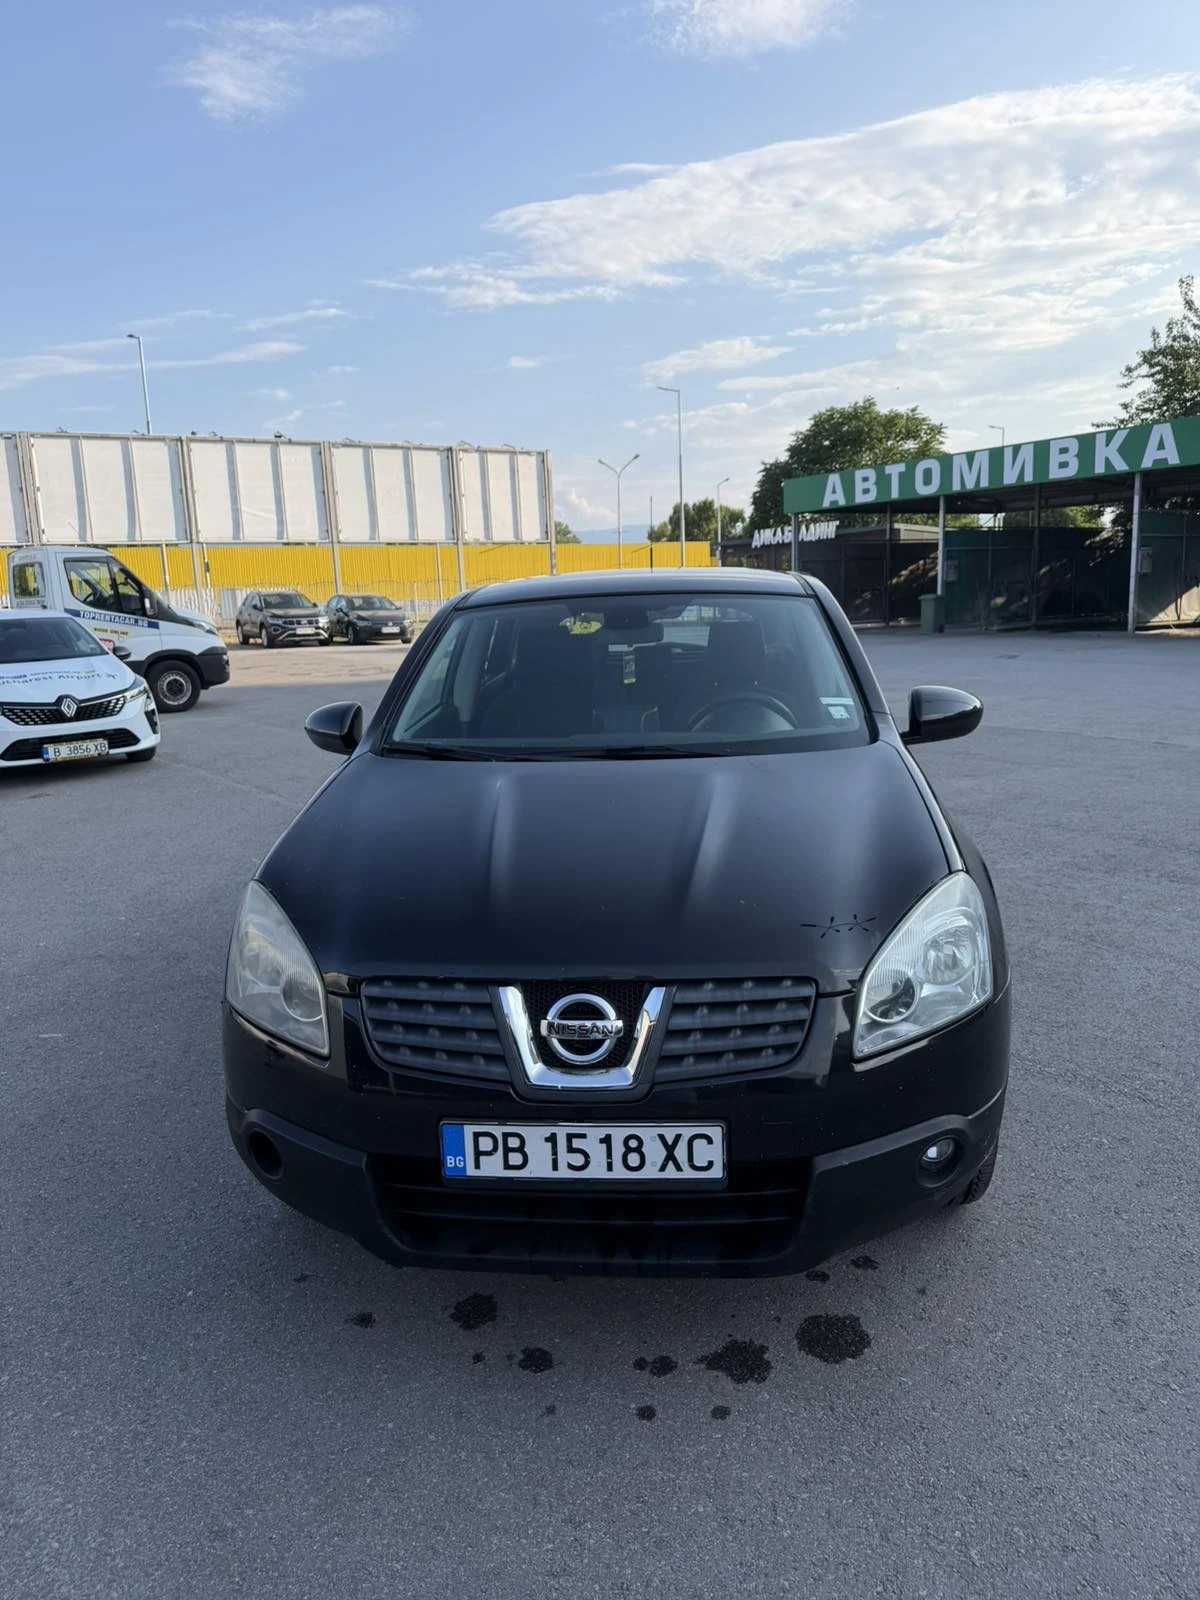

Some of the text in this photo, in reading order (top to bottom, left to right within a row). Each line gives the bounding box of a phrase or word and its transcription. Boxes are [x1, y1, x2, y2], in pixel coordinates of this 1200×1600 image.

[822, 422, 1180, 508] АВТОМИВКА
[53, 747, 61, 757] B
[66, 744, 91, 756] 3856
[547, 1022, 614, 1036] NISSAN
[472, 1131, 714, 1172] PB 1518 XC
[447, 1155, 464, 1168] BG
